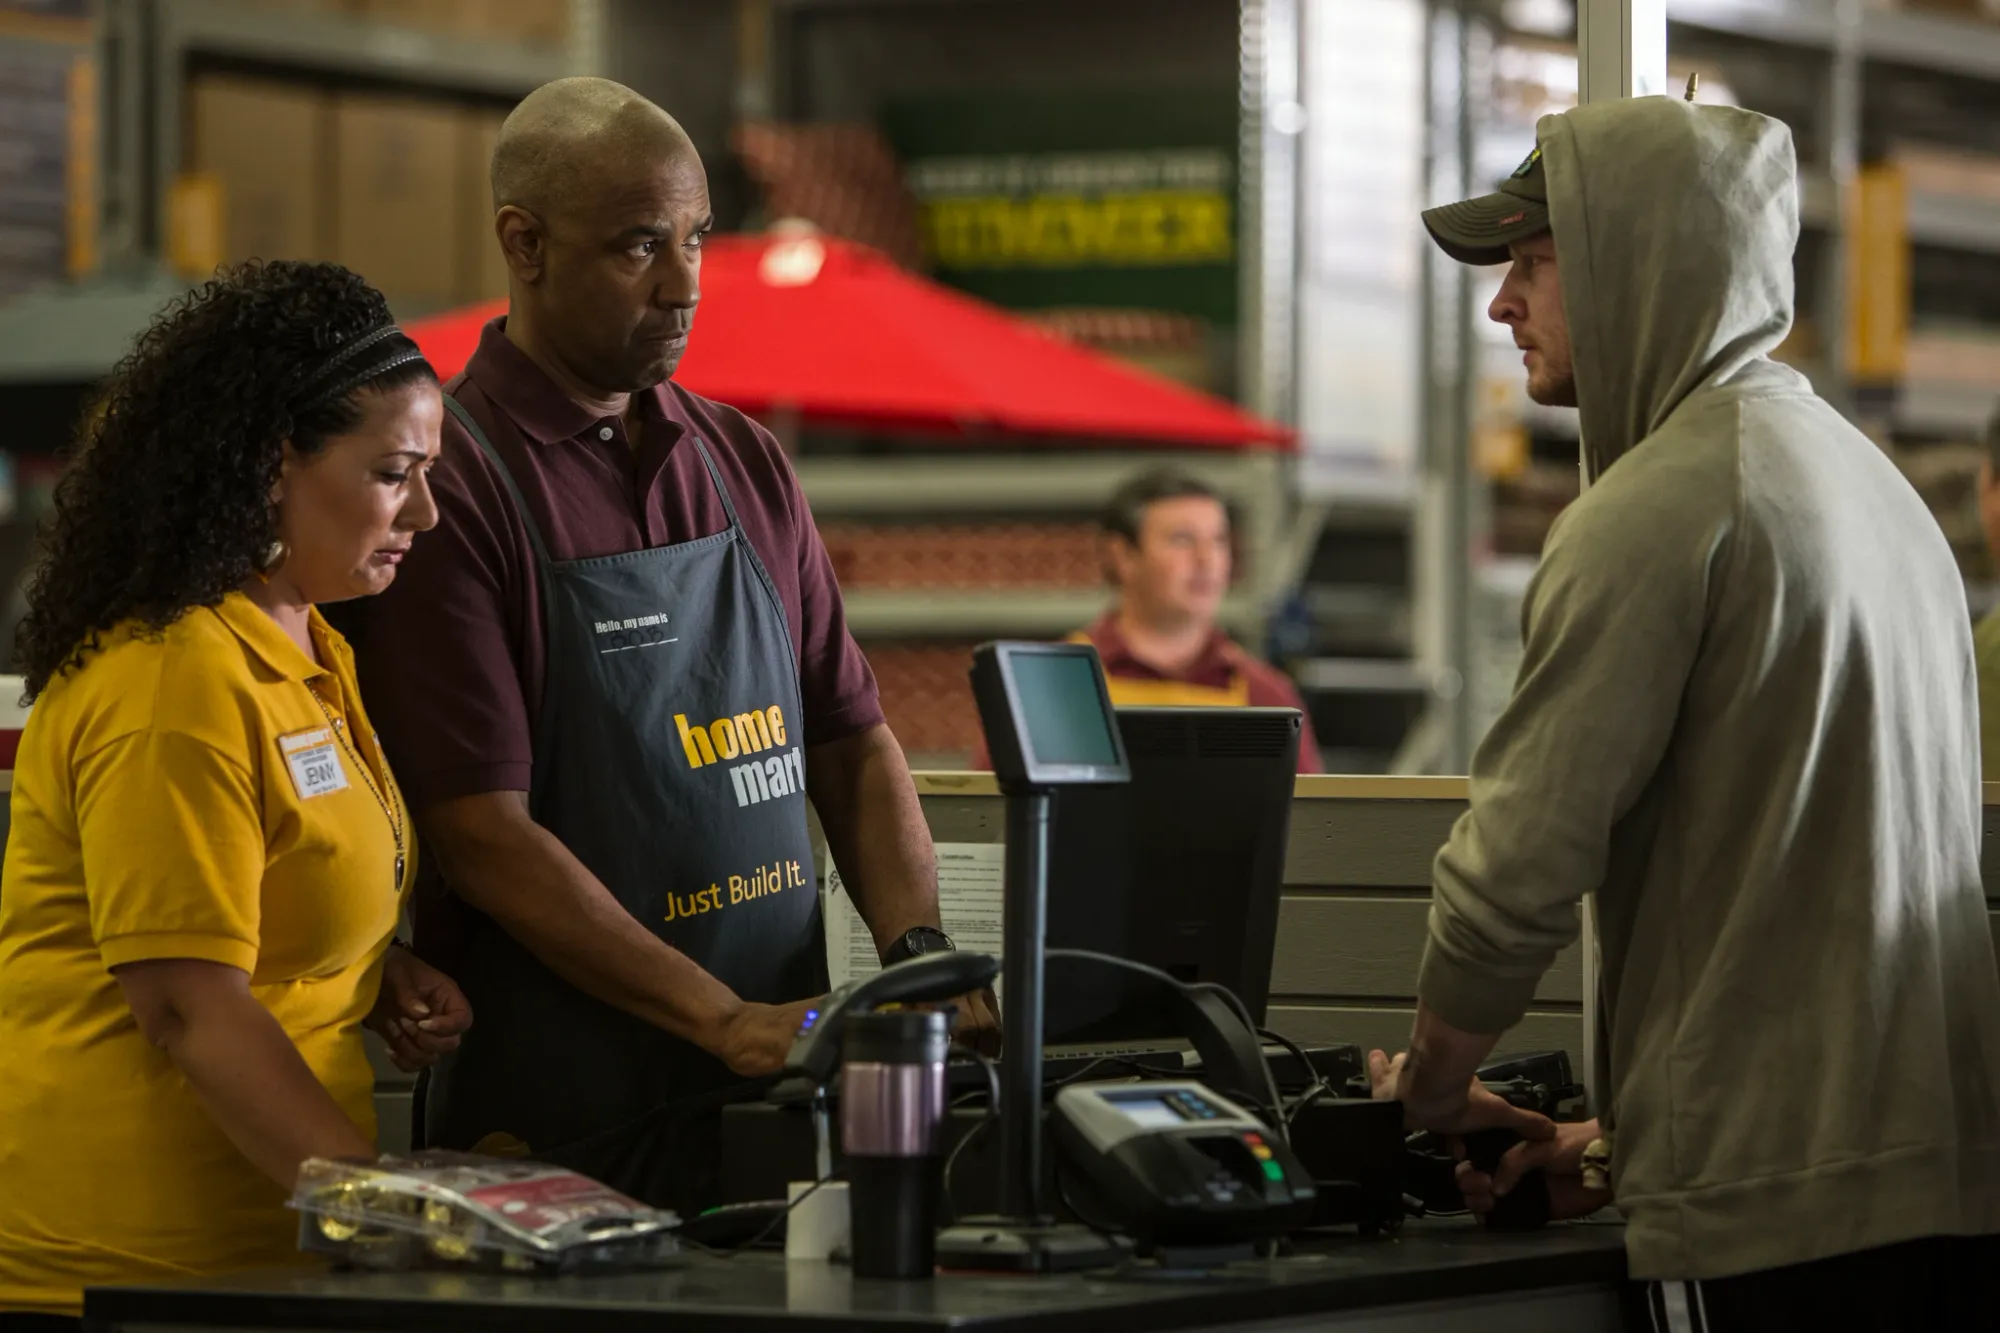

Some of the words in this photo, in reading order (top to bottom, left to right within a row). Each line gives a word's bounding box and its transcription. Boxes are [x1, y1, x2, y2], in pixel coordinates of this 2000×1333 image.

[595, 620, 623, 633] Hello,
[623, 617, 638, 629] my
[638, 614, 660, 627] name
[659, 612, 668, 623] is
[673, 704, 787, 769] home
[305, 762, 336, 786] JENNY
[729, 746, 806, 808] mart
[664, 883, 724, 922] Just
[727, 861, 782, 905] Build
[785, 860, 807, 890] It.
